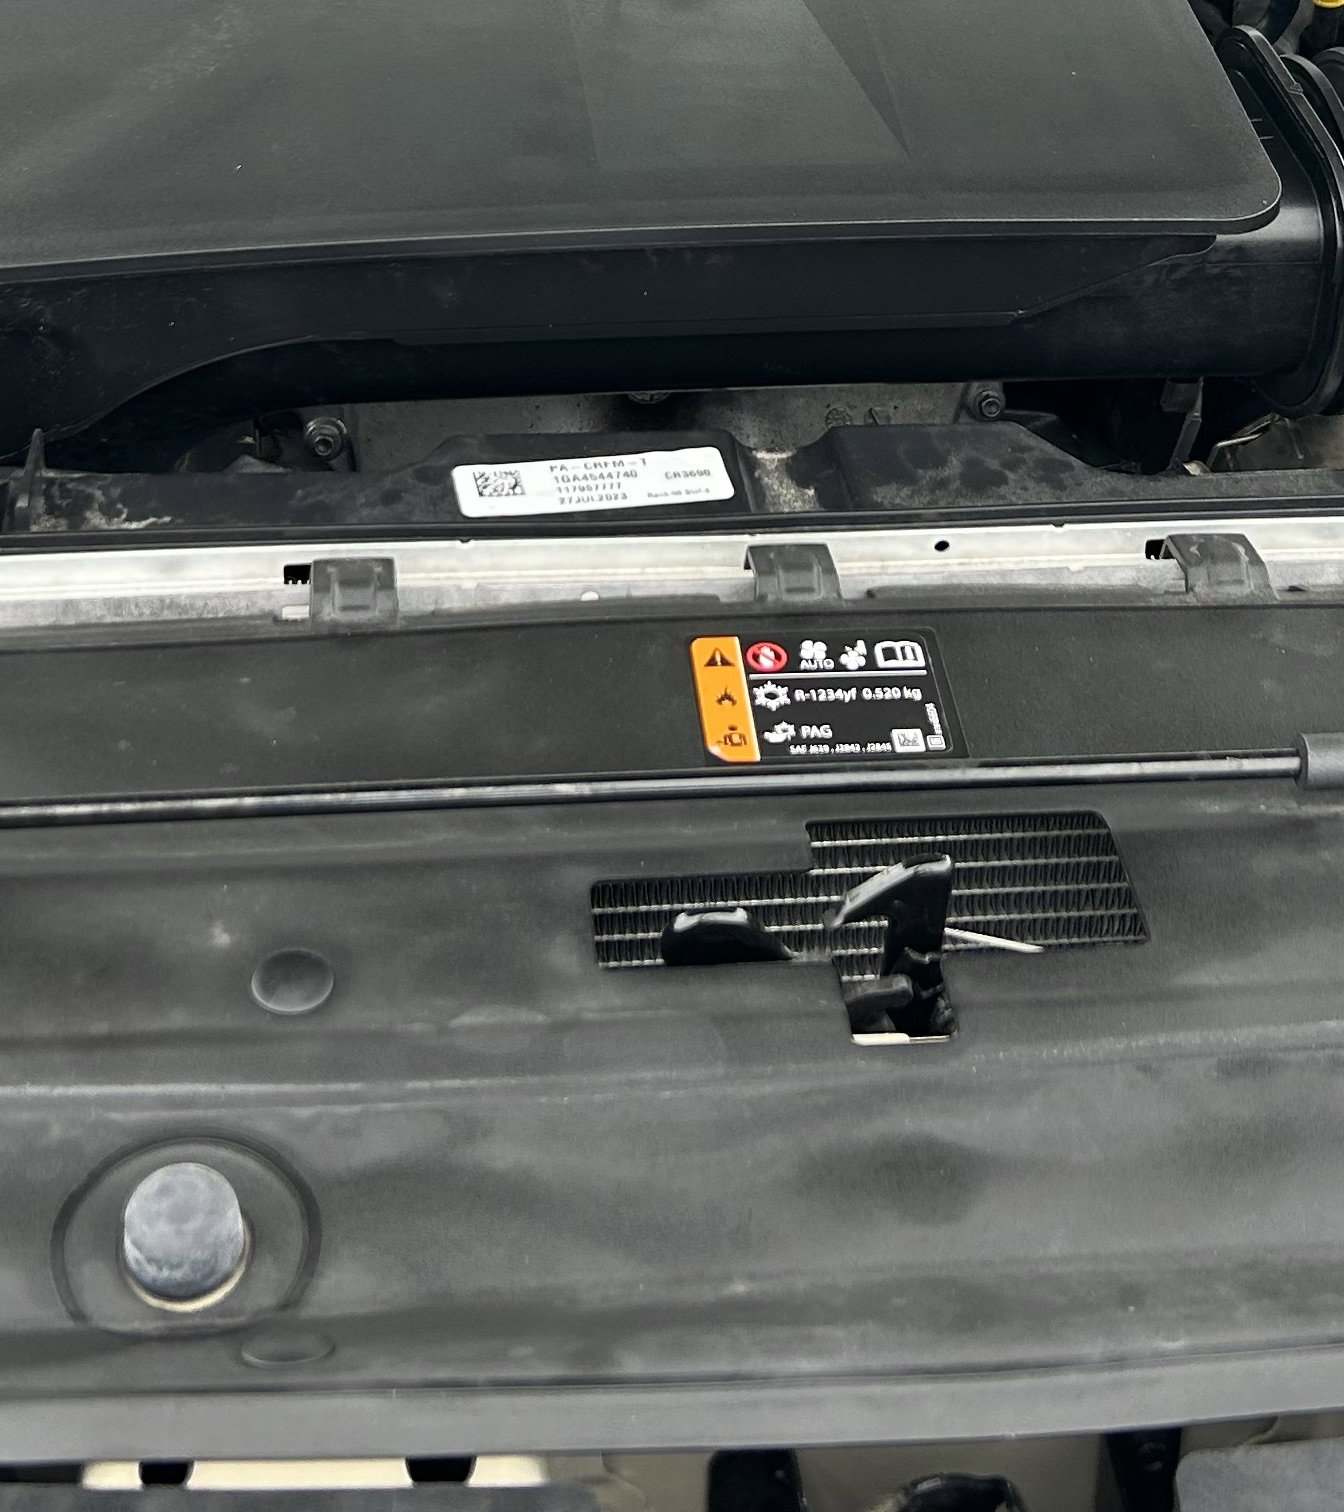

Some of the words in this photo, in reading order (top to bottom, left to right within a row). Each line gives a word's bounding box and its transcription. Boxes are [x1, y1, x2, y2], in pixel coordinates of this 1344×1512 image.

[799, 658, 835, 670] AUTO
[794, 688, 857, 703] R-1234yf
[862, 687, 901, 700] 0.520
[903, 685, 923, 702] kg
[800, 724, 833, 739] PAG
